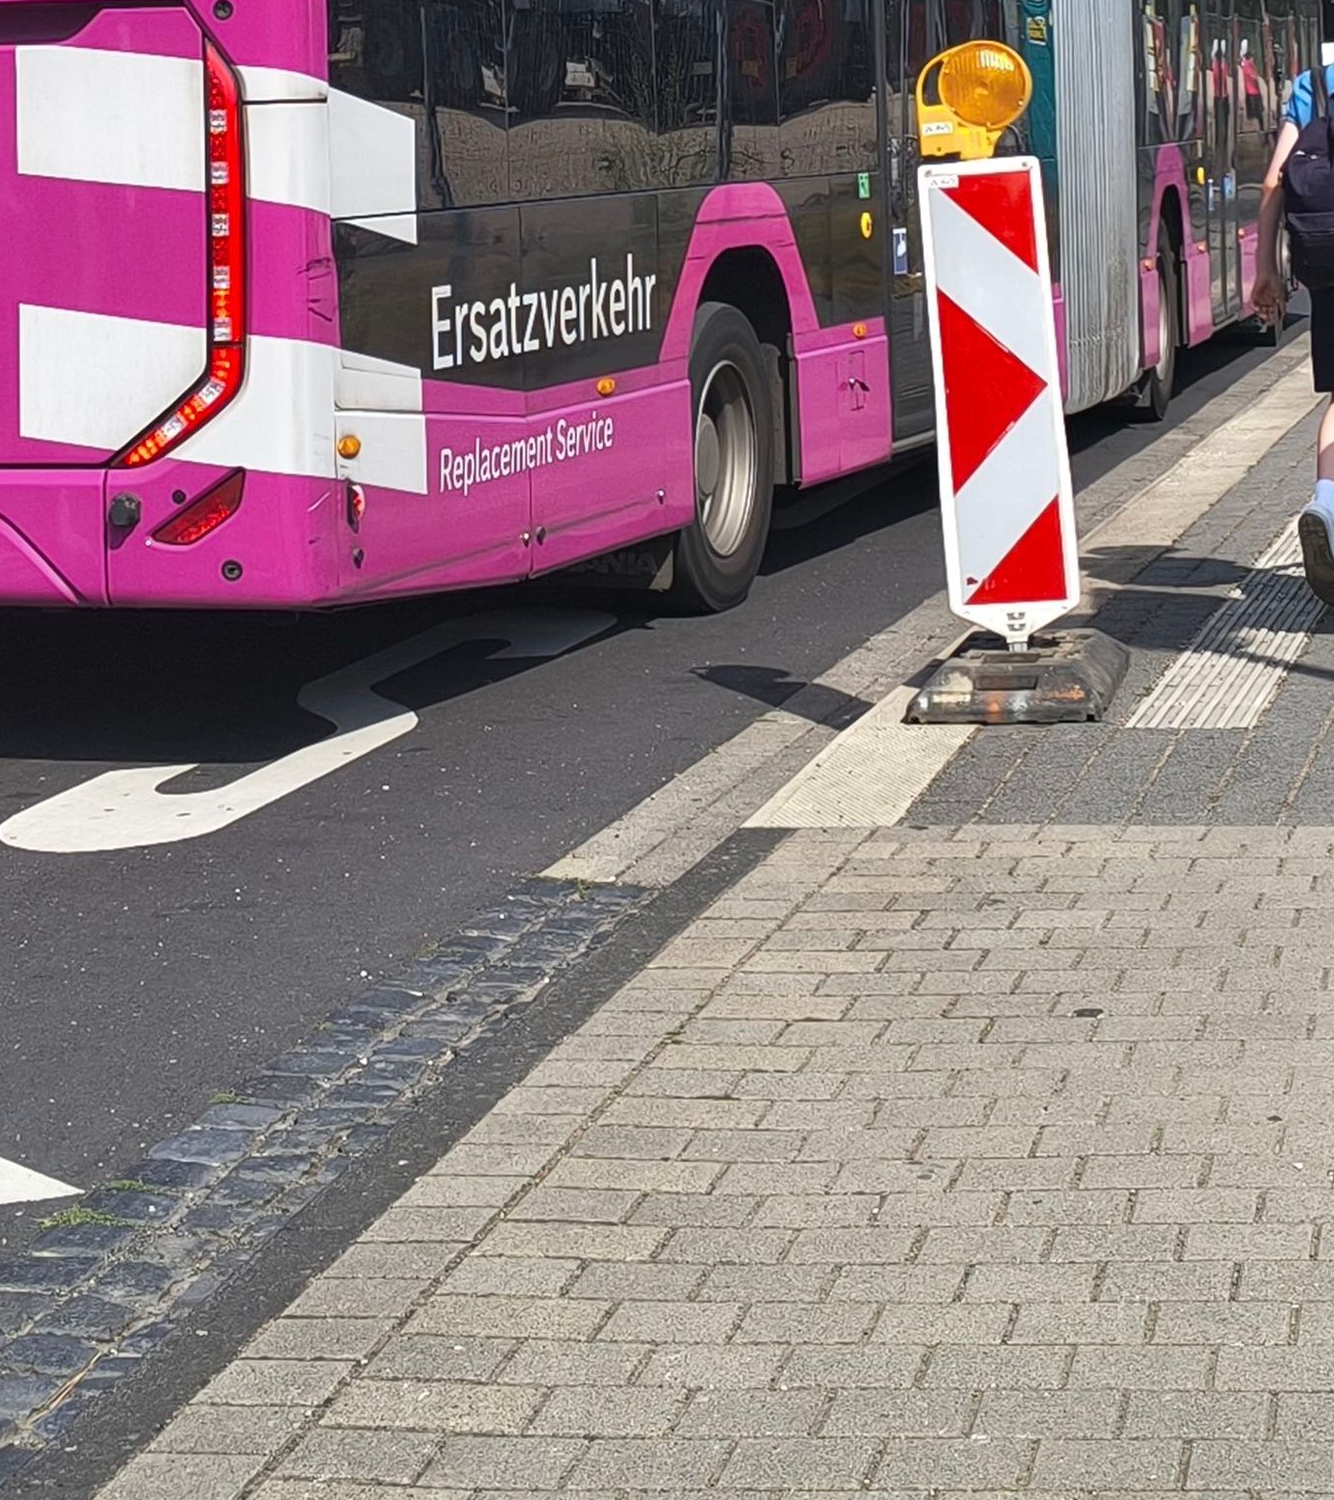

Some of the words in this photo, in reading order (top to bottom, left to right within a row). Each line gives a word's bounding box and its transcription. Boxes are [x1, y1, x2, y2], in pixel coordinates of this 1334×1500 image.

[431, 253, 657, 371] Ersatzverkehr
[439, 425, 553, 496] Replacement
[556, 410, 614, 461] Service
